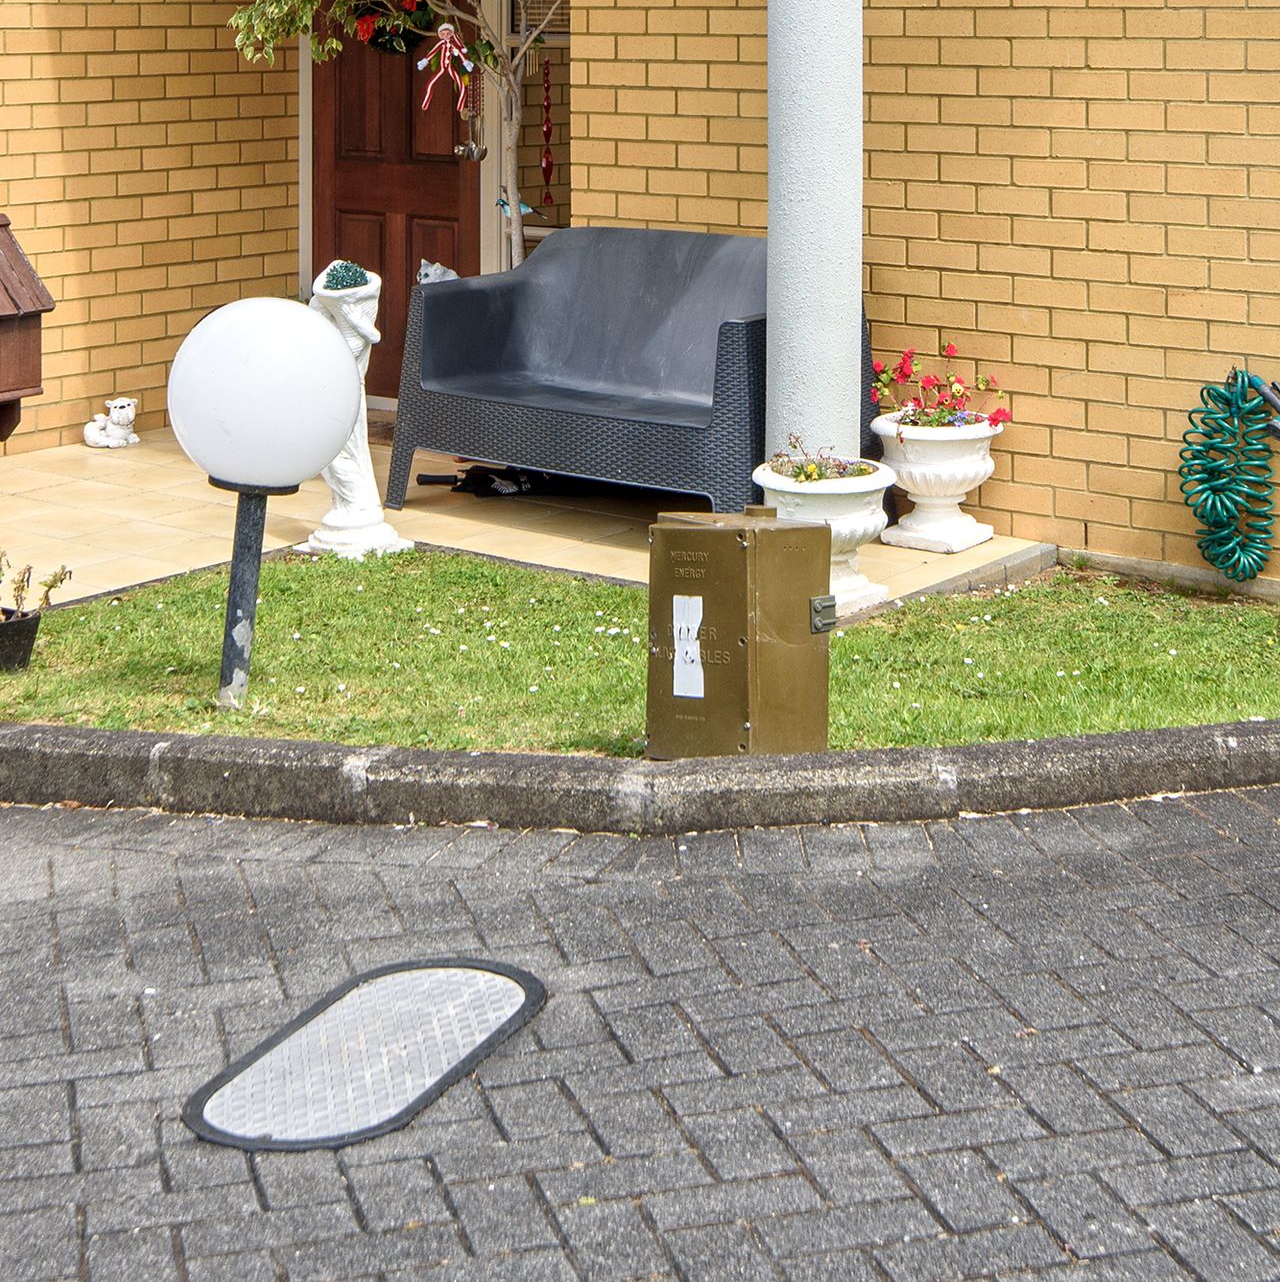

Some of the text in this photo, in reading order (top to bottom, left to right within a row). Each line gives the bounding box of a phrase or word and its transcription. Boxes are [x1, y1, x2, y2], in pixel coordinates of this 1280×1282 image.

[670, 549, 710, 563] MERCURY
[674, 567, 706, 579] ENERGY
[667, 623, 717, 641] DER
